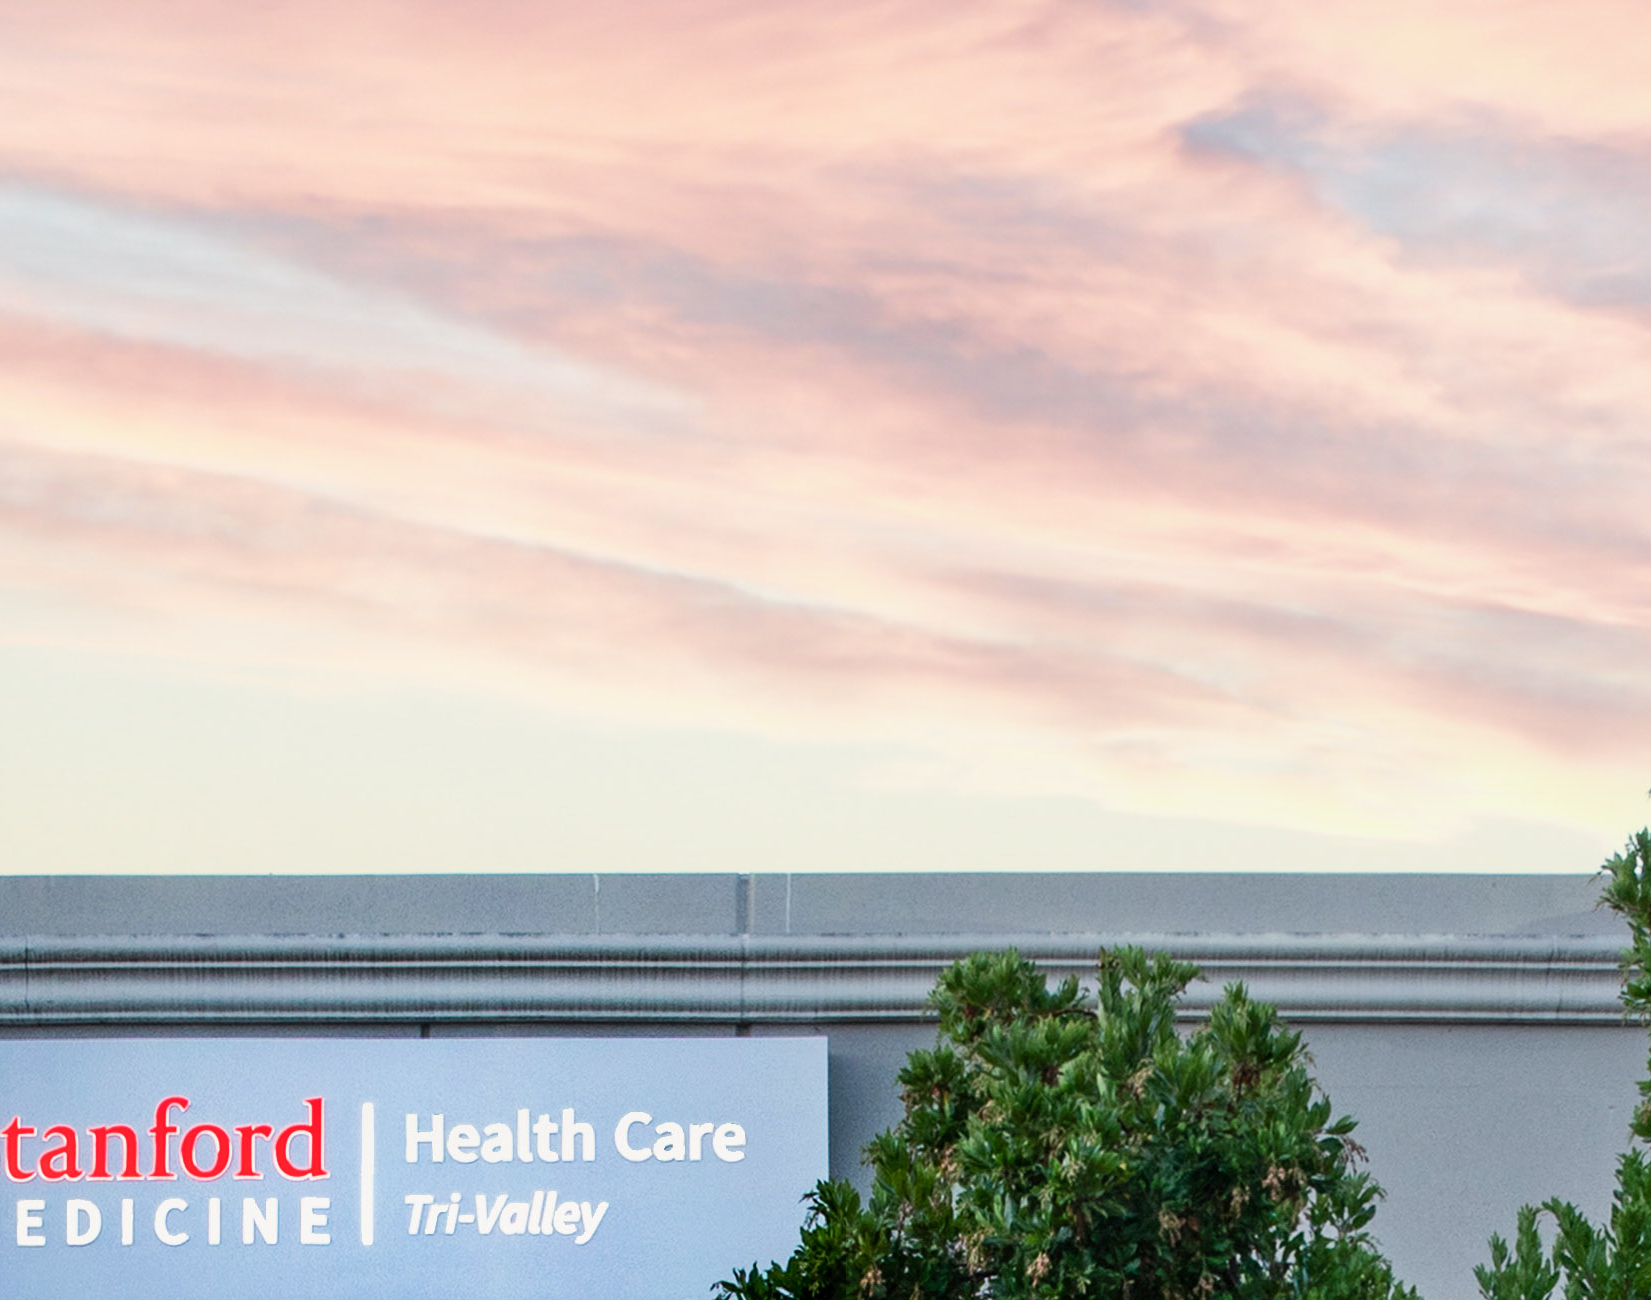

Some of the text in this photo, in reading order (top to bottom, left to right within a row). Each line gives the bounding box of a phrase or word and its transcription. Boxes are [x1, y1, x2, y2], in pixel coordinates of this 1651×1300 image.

[405, 1107, 746, 1163] Health Care
[404, 1190, 609, 1245] Tri-Valley
